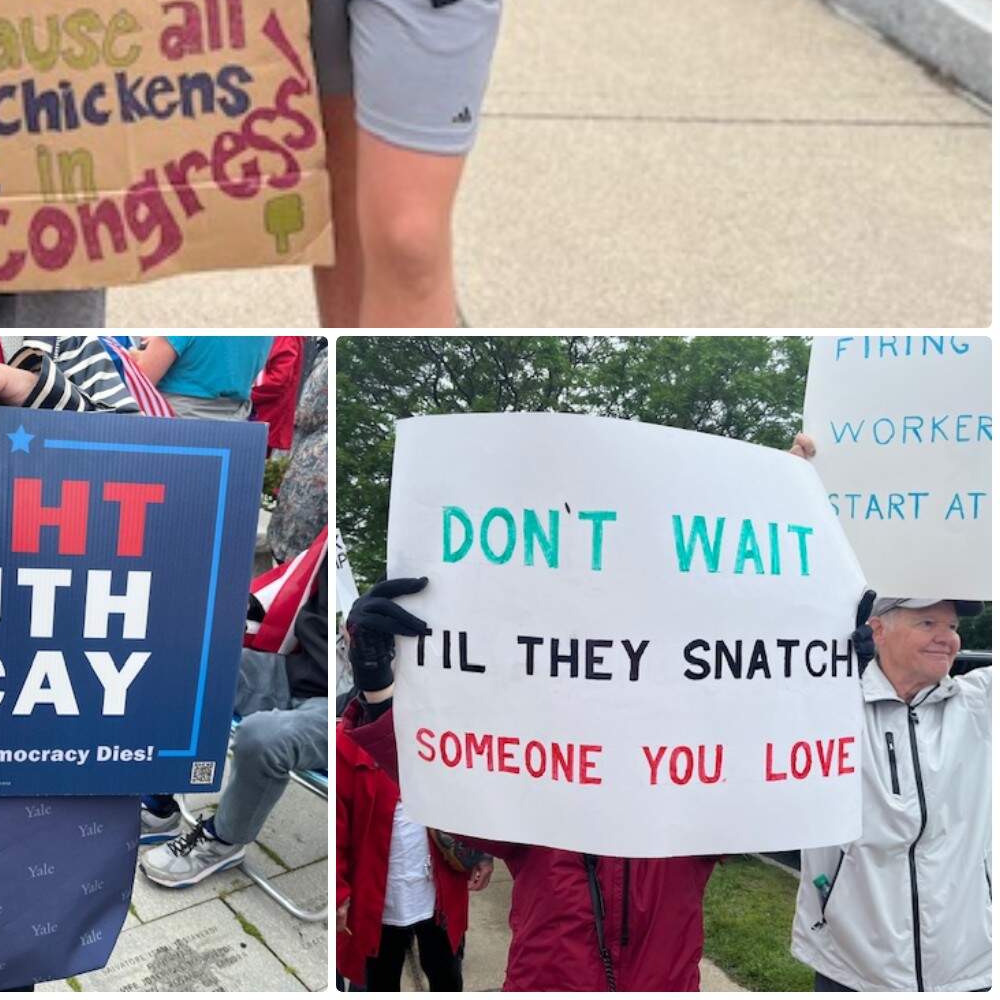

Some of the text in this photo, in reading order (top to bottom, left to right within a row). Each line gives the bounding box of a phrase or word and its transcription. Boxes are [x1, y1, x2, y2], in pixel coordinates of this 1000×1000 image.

[35, 144, 99, 204] in
[836, 336, 969, 361] FIRING
[830, 415, 992, 445] WORKER
[828, 493, 987, 521] START AT
[442, 502, 814, 577] DON'T WAIT
[517, 635, 650, 682] THEY
[683, 638, 853, 681] SNATCH
[96, 745, 154, 762] Dies!
[415, 727, 855, 786] SOMEONE YOU LOVE
[25, 804, 52, 819] Yale
[78, 822, 104, 838] Yale
[28, 863, 55, 879] Yale
[31, 922, 58, 937] Yale
